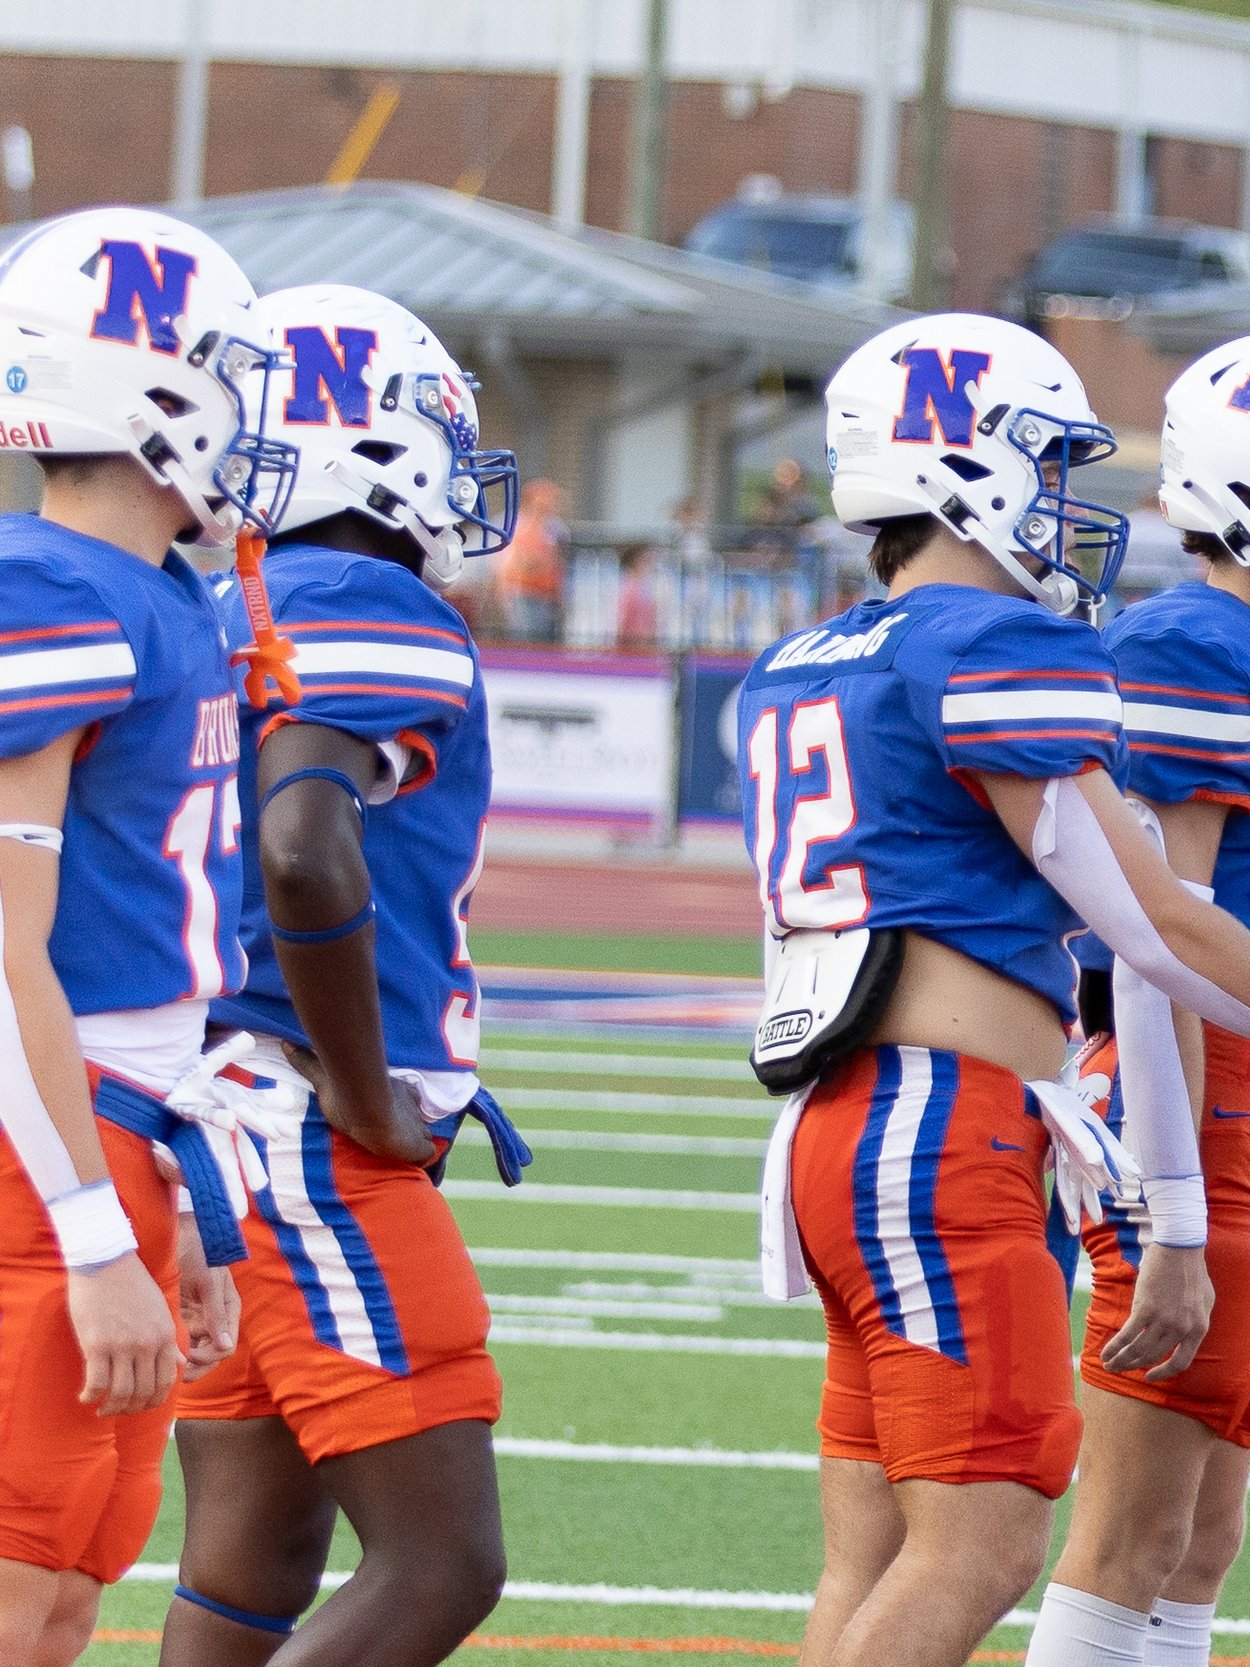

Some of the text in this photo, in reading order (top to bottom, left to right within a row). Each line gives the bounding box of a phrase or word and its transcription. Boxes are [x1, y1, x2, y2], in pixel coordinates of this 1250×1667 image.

[89, 238, 199, 359] N
[283, 325, 379, 429] N
[890, 347, 993, 449] N
[747, 695, 871, 937] 12
[762, 1016, 808, 1045] BATTLE
